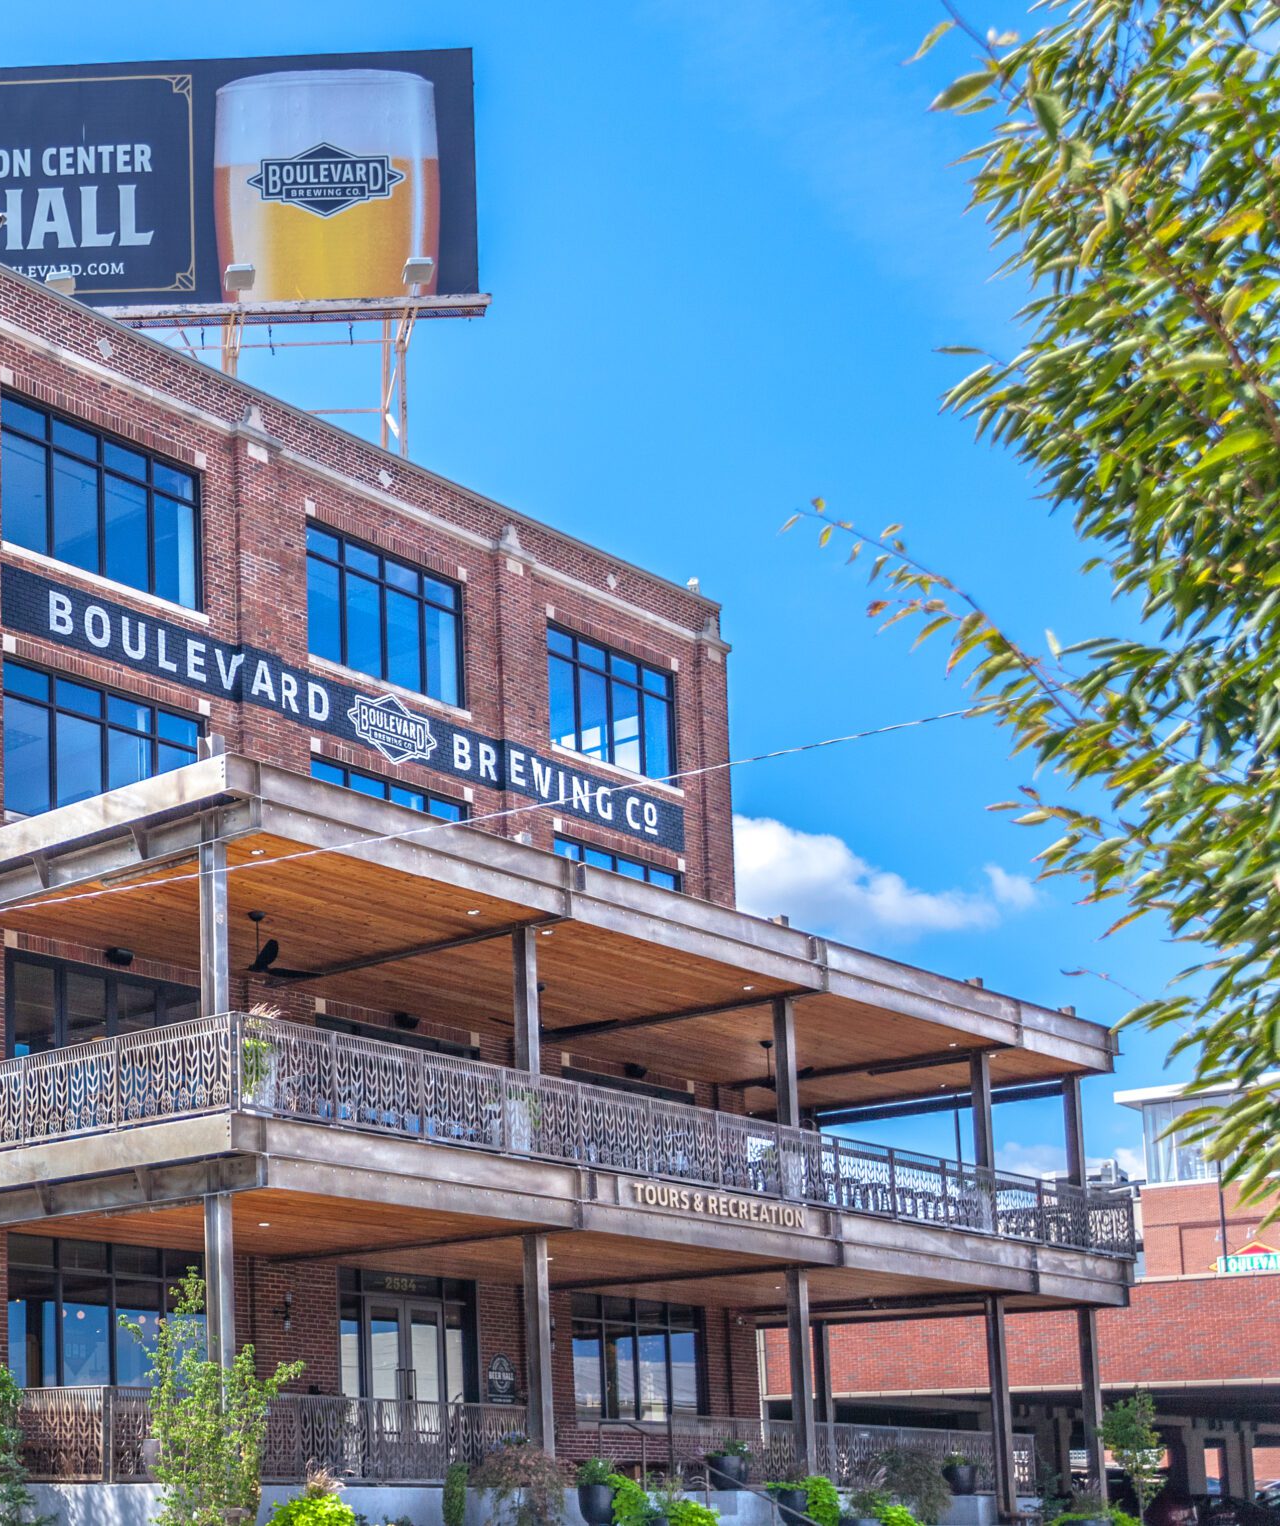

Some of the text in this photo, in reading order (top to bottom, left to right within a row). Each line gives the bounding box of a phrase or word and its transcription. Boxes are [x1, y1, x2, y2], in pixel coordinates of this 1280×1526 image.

[42, 144, 153, 176] CENTER
[268, 162, 383, 194] BOULEVARD
[290, 187, 361, 197] BREWING CO.
[48, 590, 330, 722] BOULEVARD
[453, 733, 613, 820] BREWING
[361, 705, 425, 750] BOULEVARD
[373, 731, 402, 747] BREWING
[633, 1182, 805, 1228] TOURS & RECREATION
[385, 1277, 417, 1291] 2534
[489, 1371, 501, 1380] BEER
